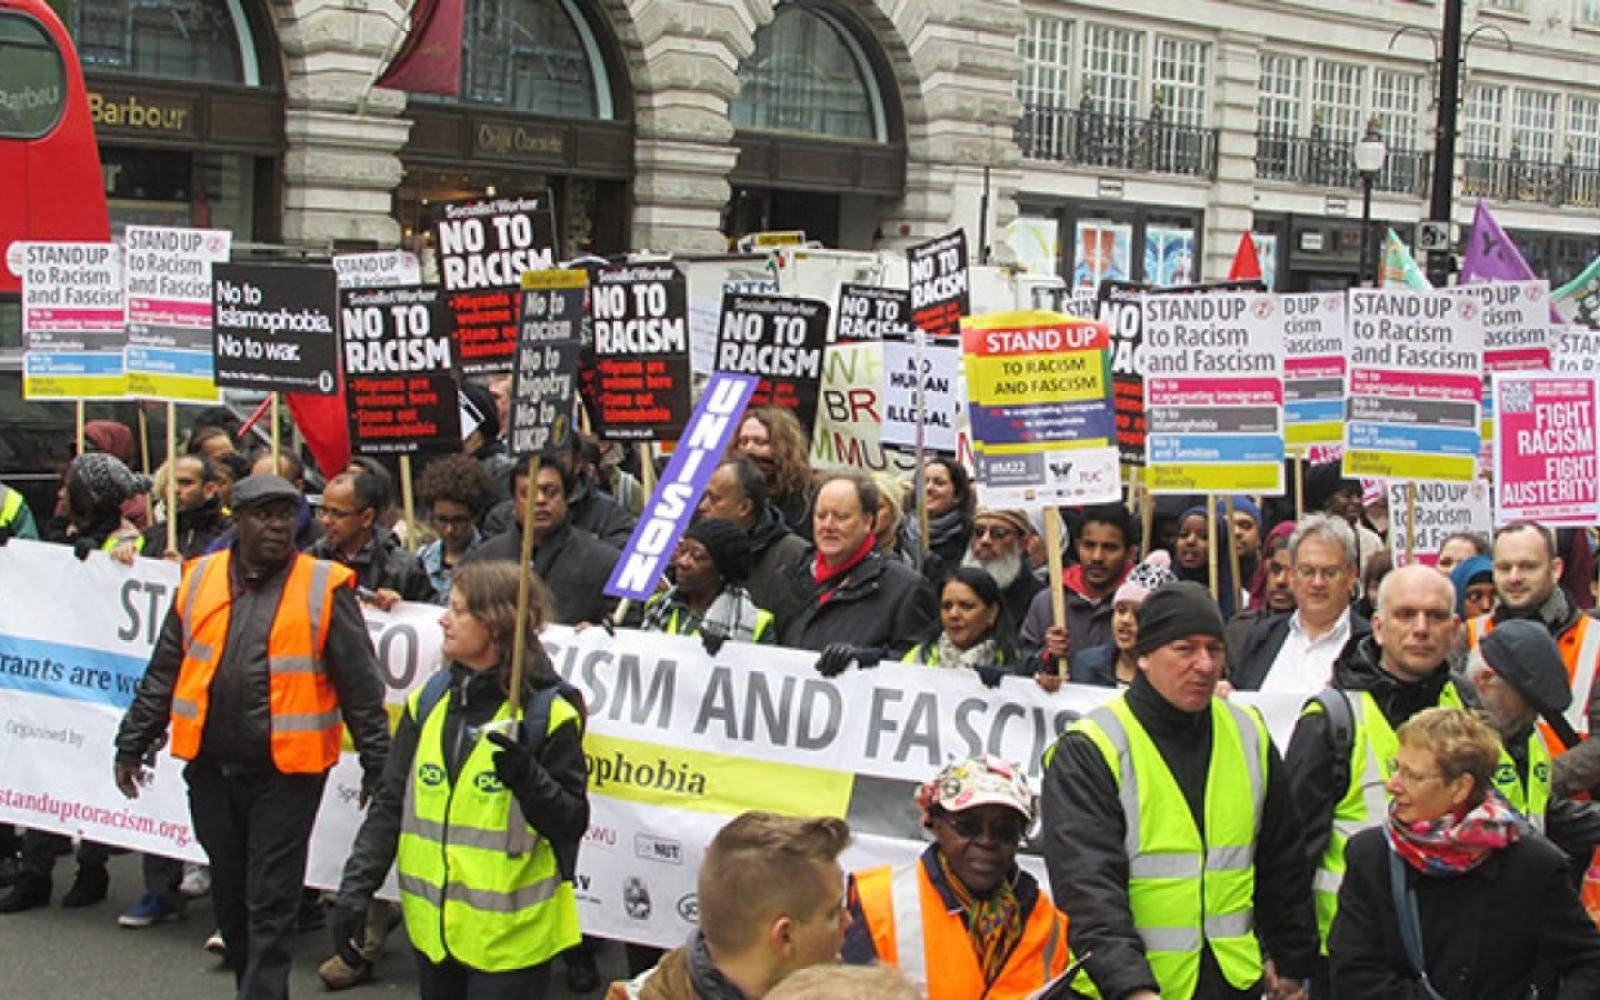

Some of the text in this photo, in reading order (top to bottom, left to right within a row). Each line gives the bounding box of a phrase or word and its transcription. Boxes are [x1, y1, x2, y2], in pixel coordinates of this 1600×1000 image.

[87, 93, 186, 129] Barbour
[129, 231, 201, 251] STAND UP
[440, 214, 533, 255] NO TO
[27, 246, 109, 265] STAND UP
[129, 254, 202, 275] to Racism
[911, 256, 933, 283] NO
[939, 248, 959, 274] TO
[27, 267, 111, 284] to Racism
[444, 248, 552, 290] RACISM
[27, 288, 59, 304] and
[129, 277, 157, 293] and
[217, 280, 261, 305] No to
[911, 269, 967, 309] RACISM
[1497, 285, 1521, 303] UP
[525, 291, 565, 316] No to
[592, 283, 666, 319] NO TO
[842, 296, 899, 320] NO TO
[1147, 298, 1246, 322] STAND UP
[1298, 297, 1320, 314] UP
[1354, 293, 1451, 319] STAND UP
[217, 305, 333, 334] Islamophobia.
[343, 307, 383, 340] NO
[391, 304, 430, 338] TO
[522, 318, 572, 340] racism
[723, 311, 806, 346] NO TO
[1100, 303, 1139, 338] NO
[1354, 319, 1452, 342] to Racism
[218, 333, 263, 359] No to
[595, 318, 685, 354] RACISM
[986, 325, 1098, 353] STAND UP
[1147, 324, 1249, 347] to Racism
[265, 342, 300, 361] war.
[345, 337, 451, 374] RACISM
[520, 347, 542, 371] No
[544, 346, 560, 370] to
[720, 342, 820, 378] RACISM
[1149, 350, 1188, 371] and
[1194, 350, 1275, 371] Fascism
[1352, 343, 1477, 369] and Fascism
[1002, 357, 1085, 376] TO RACISM
[517, 371, 570, 403] bigotry
[994, 375, 1097, 395] AND FASCISM
[515, 400, 556, 426] No to
[1535, 400, 1591, 429] FIGHT
[1517, 427, 1593, 456] RACISM
[1546, 456, 1594, 481] FIGHT
[616, 379, 748, 592] UNISON
[1448, 484, 1469, 501] UP
[1503, 479, 1596, 504] AUSTERITY
[1415, 503, 1471, 527] Racism
[0, 653, 65, 683] rants
[70, 665, 112, 691] are
[694, 666, 842, 750] AND
